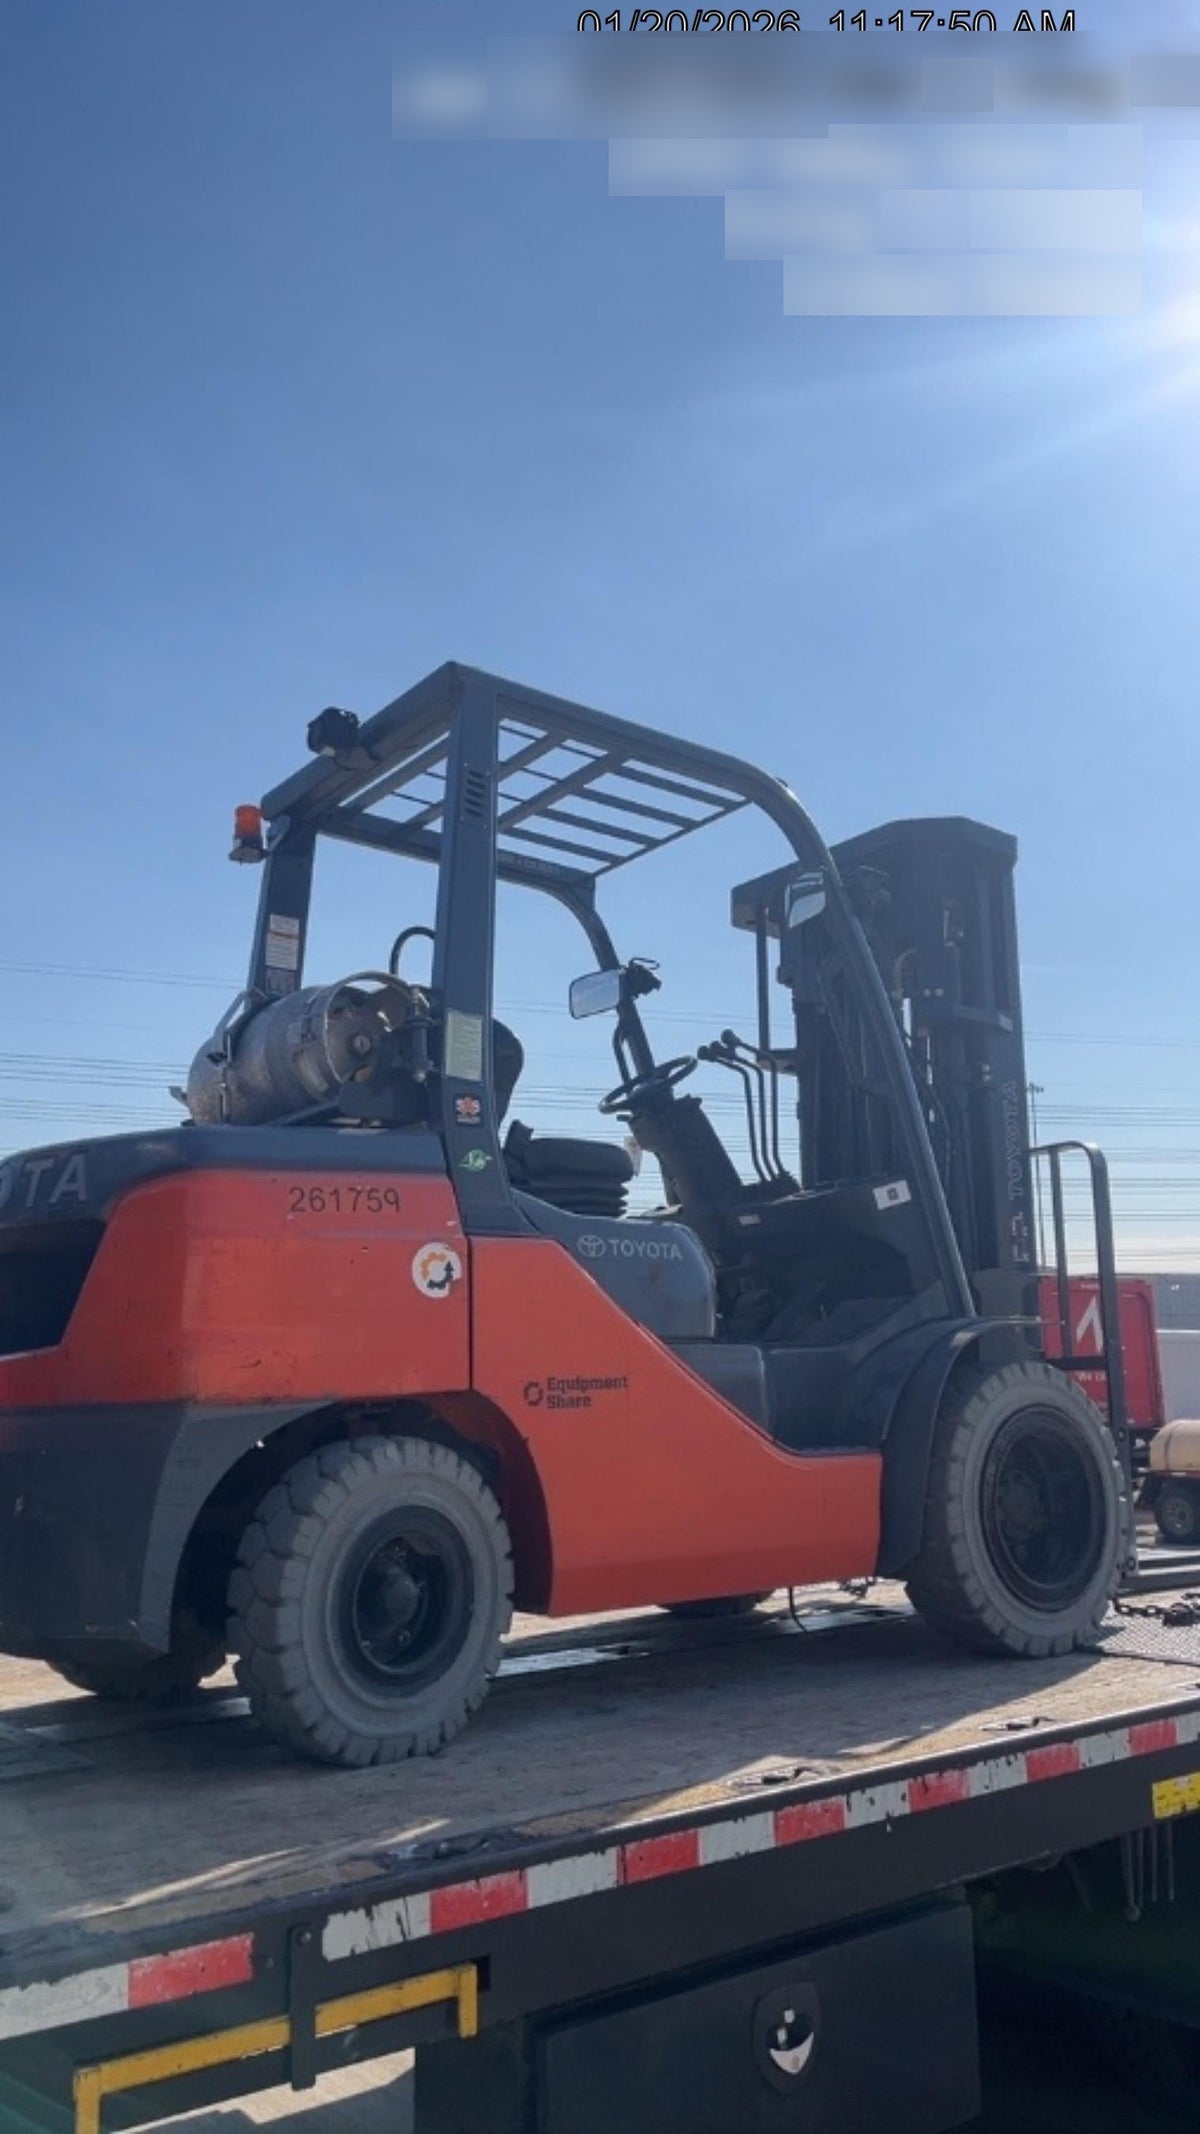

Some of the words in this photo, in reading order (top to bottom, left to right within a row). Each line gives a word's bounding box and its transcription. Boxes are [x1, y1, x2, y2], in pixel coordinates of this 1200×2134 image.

[288, 1186, 401, 1213] 261759
[607, 1239, 684, 1260] TOYOTA
[547, 1376, 629, 1394] Equipment
[547, 1394, 592, 1409] Share
